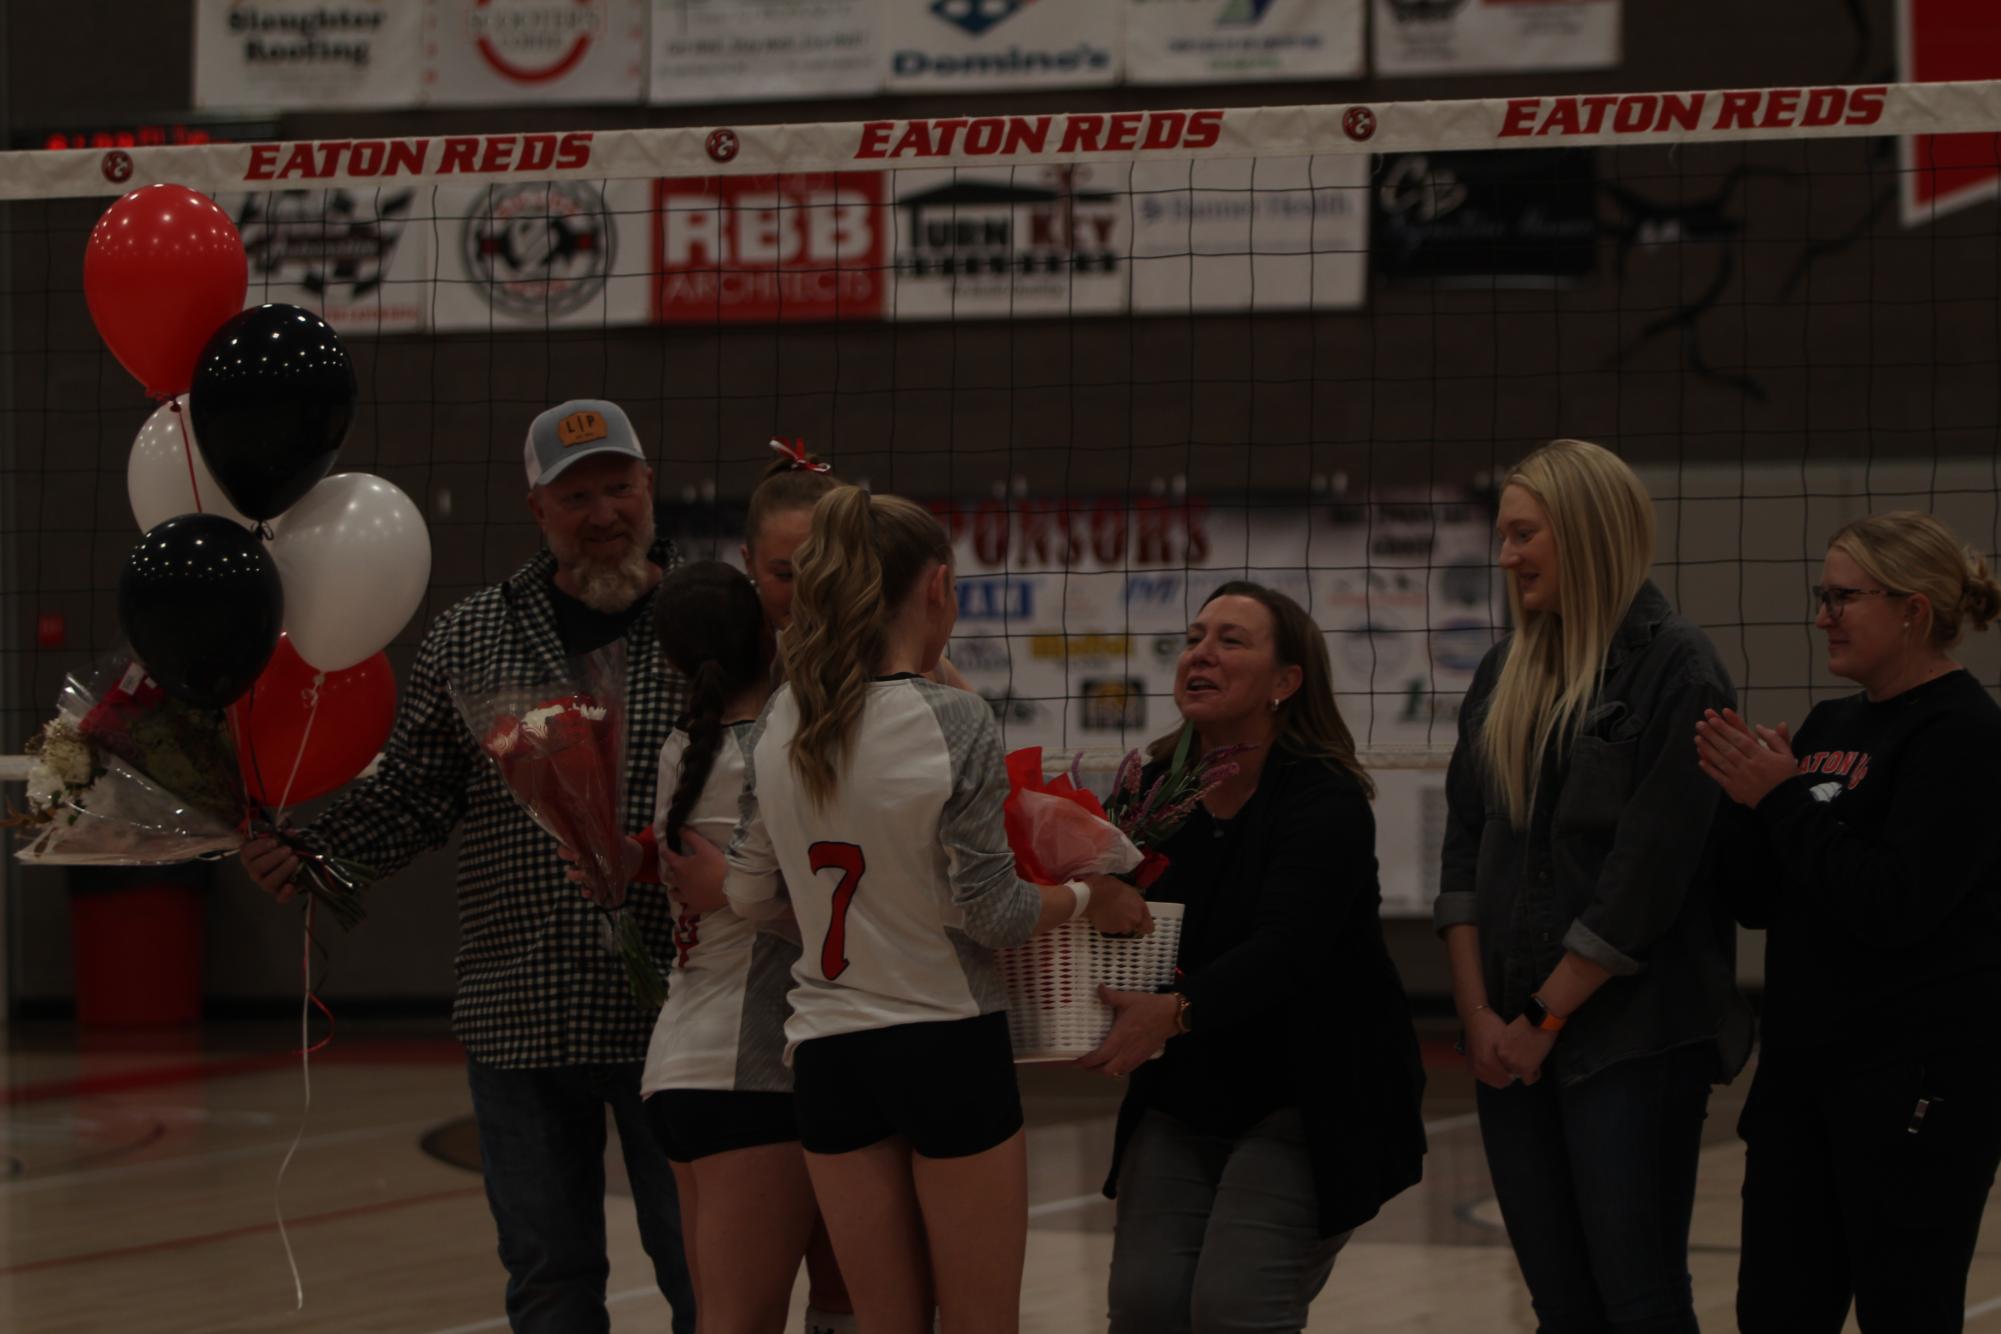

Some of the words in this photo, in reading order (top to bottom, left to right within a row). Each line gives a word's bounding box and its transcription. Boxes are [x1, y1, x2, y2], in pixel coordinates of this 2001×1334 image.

[228, 10, 384, 34] Slaughter
[246, 39, 370, 67] Roofing
[893, 46, 1109, 76] Domino's
[854, 117, 1053, 159] EATON
[1057, 107, 1225, 151] REDS
[1498, 96, 1707, 137] EATON
[1714, 87, 1886, 129] REDS
[244, 138, 431, 181] EATON
[436, 132, 595, 175] REDS
[662, 190, 873, 266] RBB
[809, 841, 866, 981] 7
